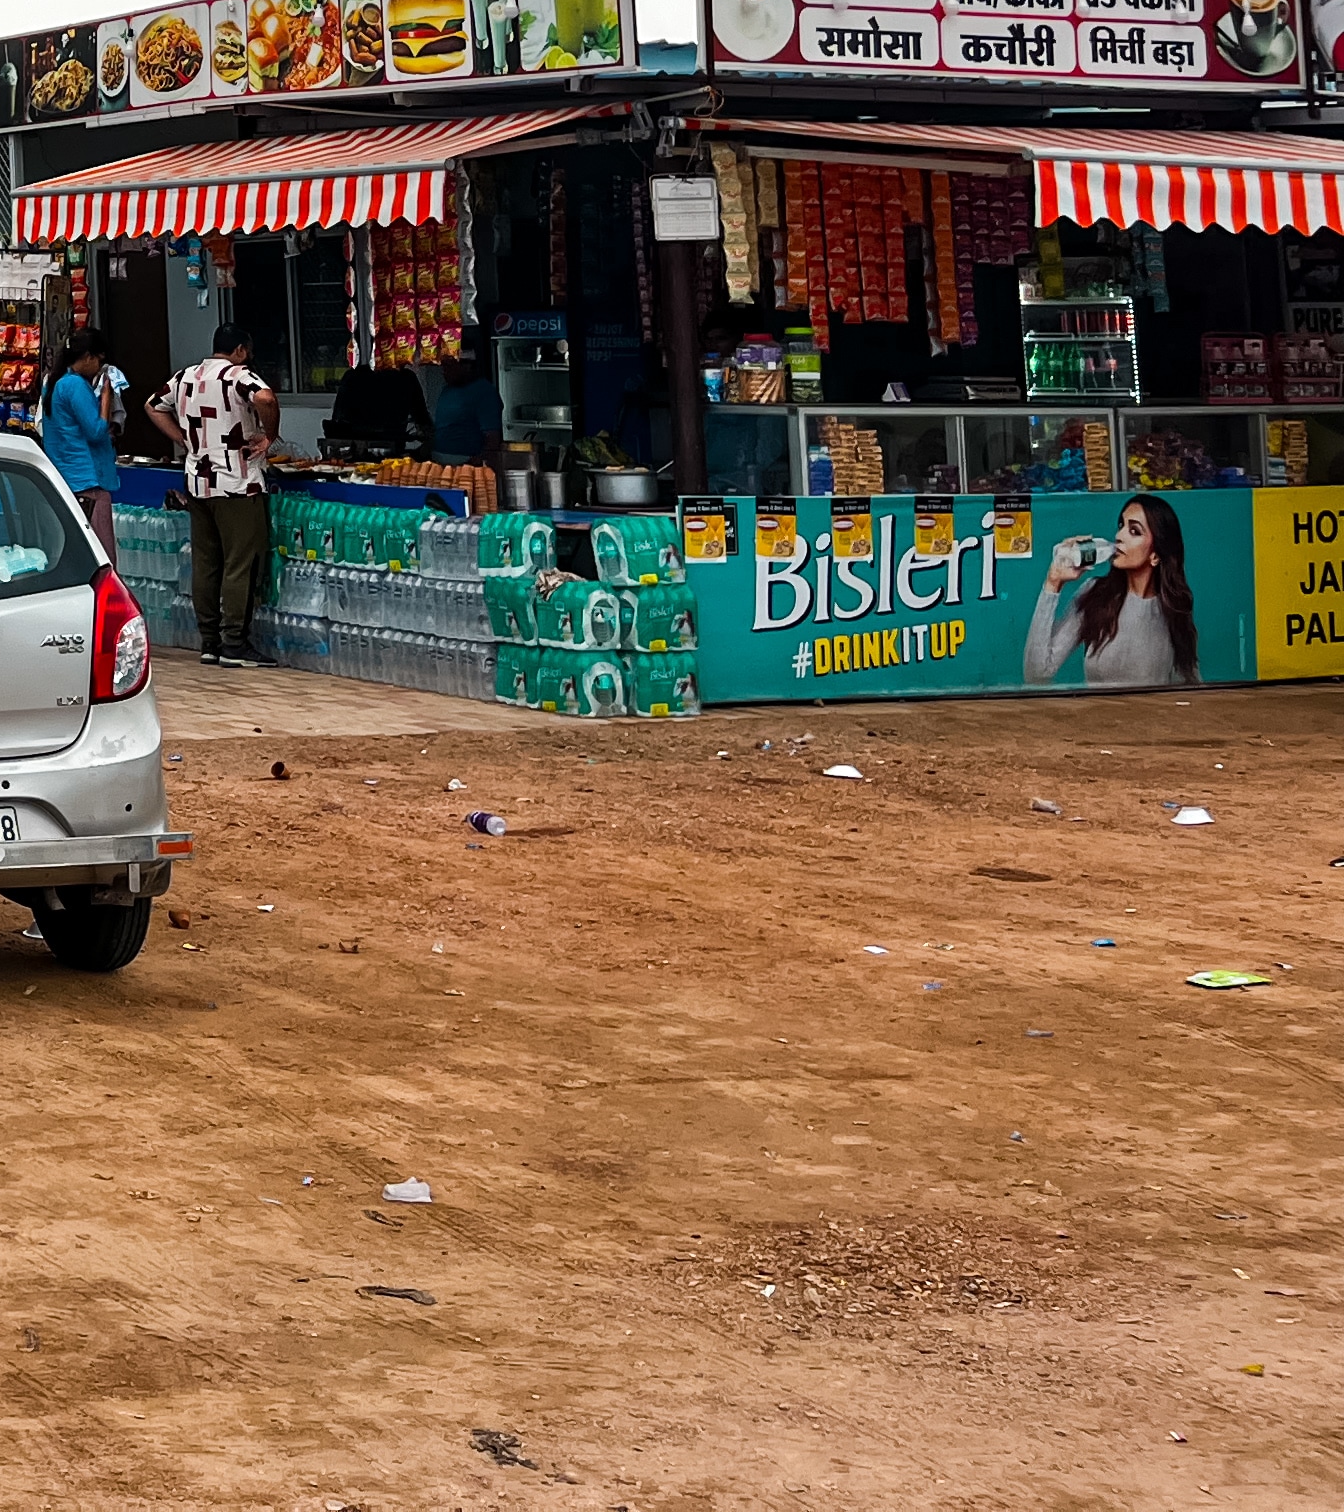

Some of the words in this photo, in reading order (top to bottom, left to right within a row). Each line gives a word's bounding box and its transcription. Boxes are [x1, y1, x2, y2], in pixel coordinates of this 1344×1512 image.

[816, 16, 923, 61] समोसा
[960, 23, 1057, 67] कचौरी
[1151, 39, 1195, 73] बड़ा
[517, 314, 561, 334] pepsi
[751, 511, 996, 631] Bisleri
[1299, 560, 1344, 595] JA
[40, 633, 85, 647] ALTO
